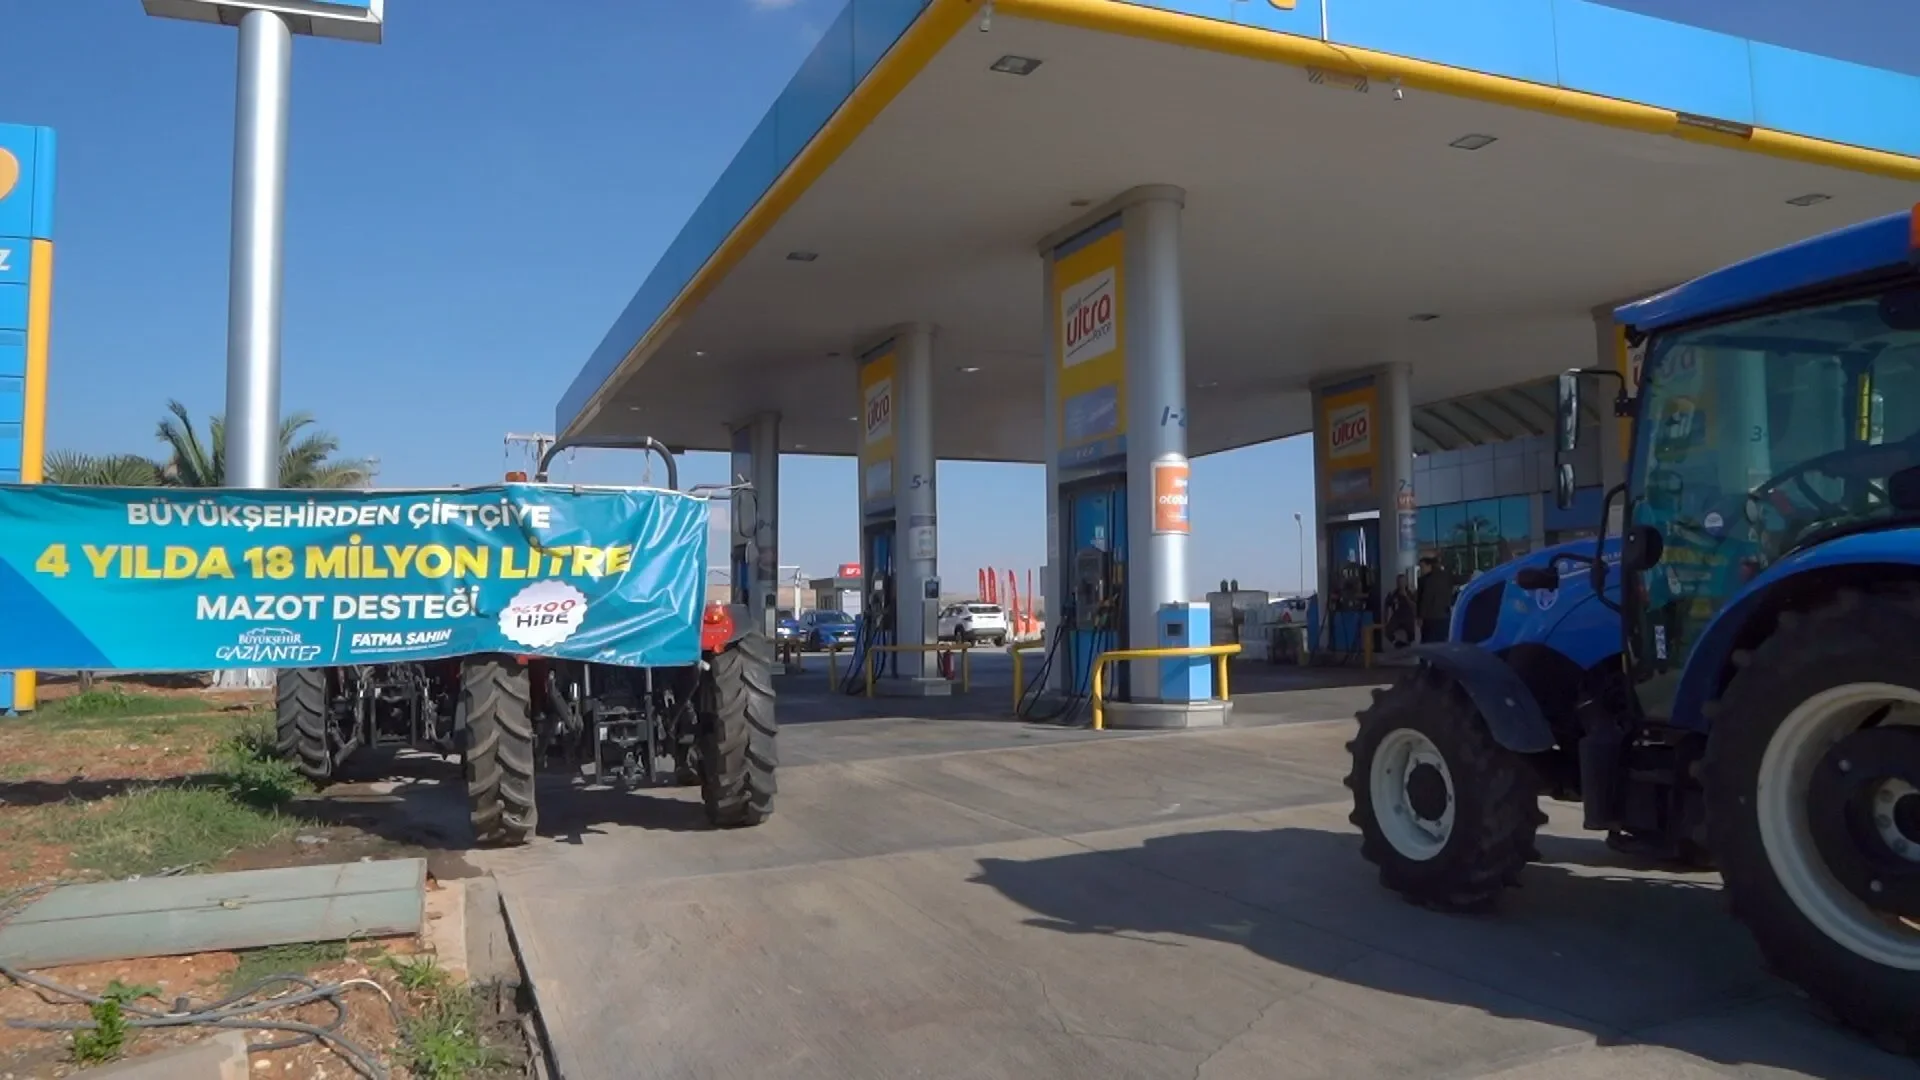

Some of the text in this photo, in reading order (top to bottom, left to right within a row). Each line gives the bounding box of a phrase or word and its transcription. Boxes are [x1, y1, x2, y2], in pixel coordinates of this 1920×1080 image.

[1066, 293, 1111, 347] ultra
[1332, 417, 1368, 447] ultra
[127, 498, 551, 531] BÜYÜKŞEHİRDEN ÇİFTÇİYE
[35, 534, 633, 580] 4 YILDA 18 MİLYON LİTRE
[196, 585, 480, 621] MAZOT DESTEĞİ
[351, 632, 403, 647] FATMA
